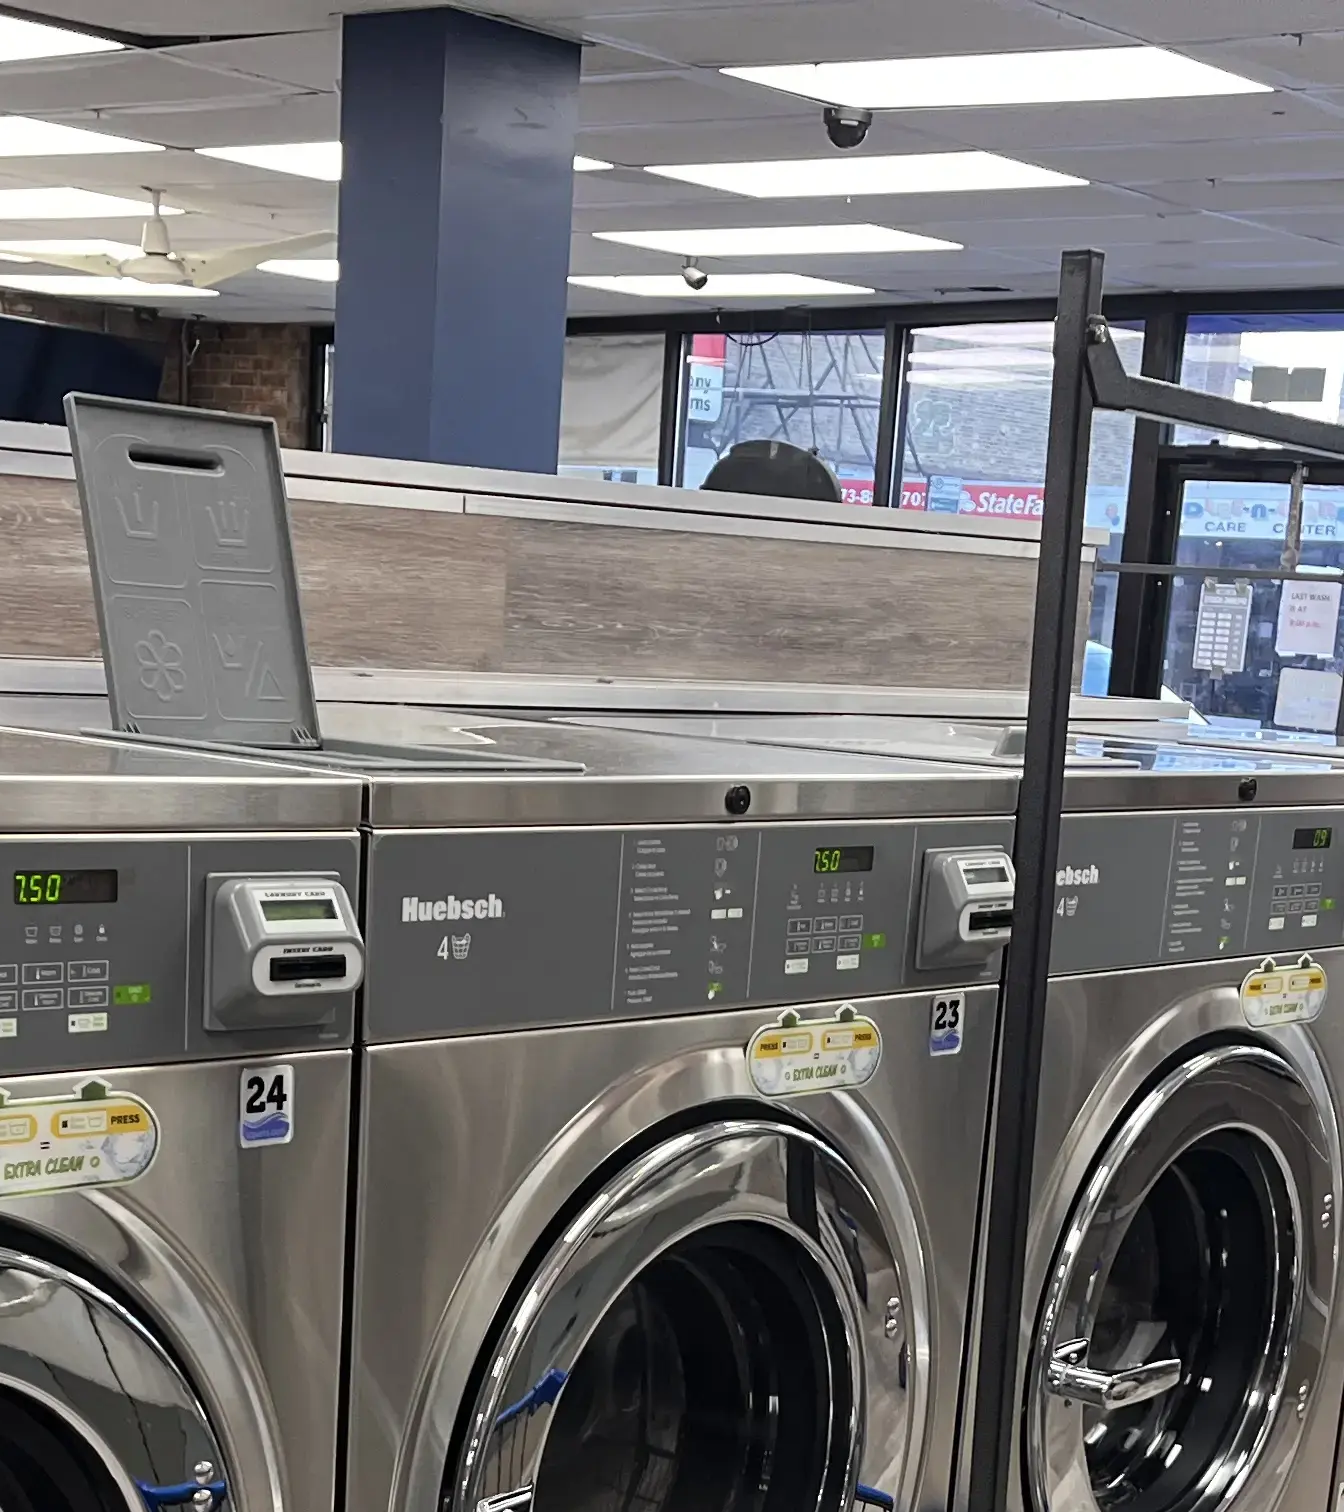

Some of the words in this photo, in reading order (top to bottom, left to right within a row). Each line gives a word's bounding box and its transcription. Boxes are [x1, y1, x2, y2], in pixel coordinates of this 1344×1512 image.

[977, 491, 1044, 516] StateFa
[1204, 521, 1247, 533] CARE
[1273, 523, 1336, 536] CTER
[1056, 864, 1100, 887] ebsch
[402, 893, 503, 922] Huebsch
[1056, 897, 1065, 917] 4
[437, 936, 449, 960] 4
[933, 999, 961, 1031] 23
[246, 1074, 288, 1114] 24
[109, 1112, 141, 1126] PRESS
[3, 1158, 43, 1181] EXTRA
[44, 1155, 86, 1177] CLEAN
